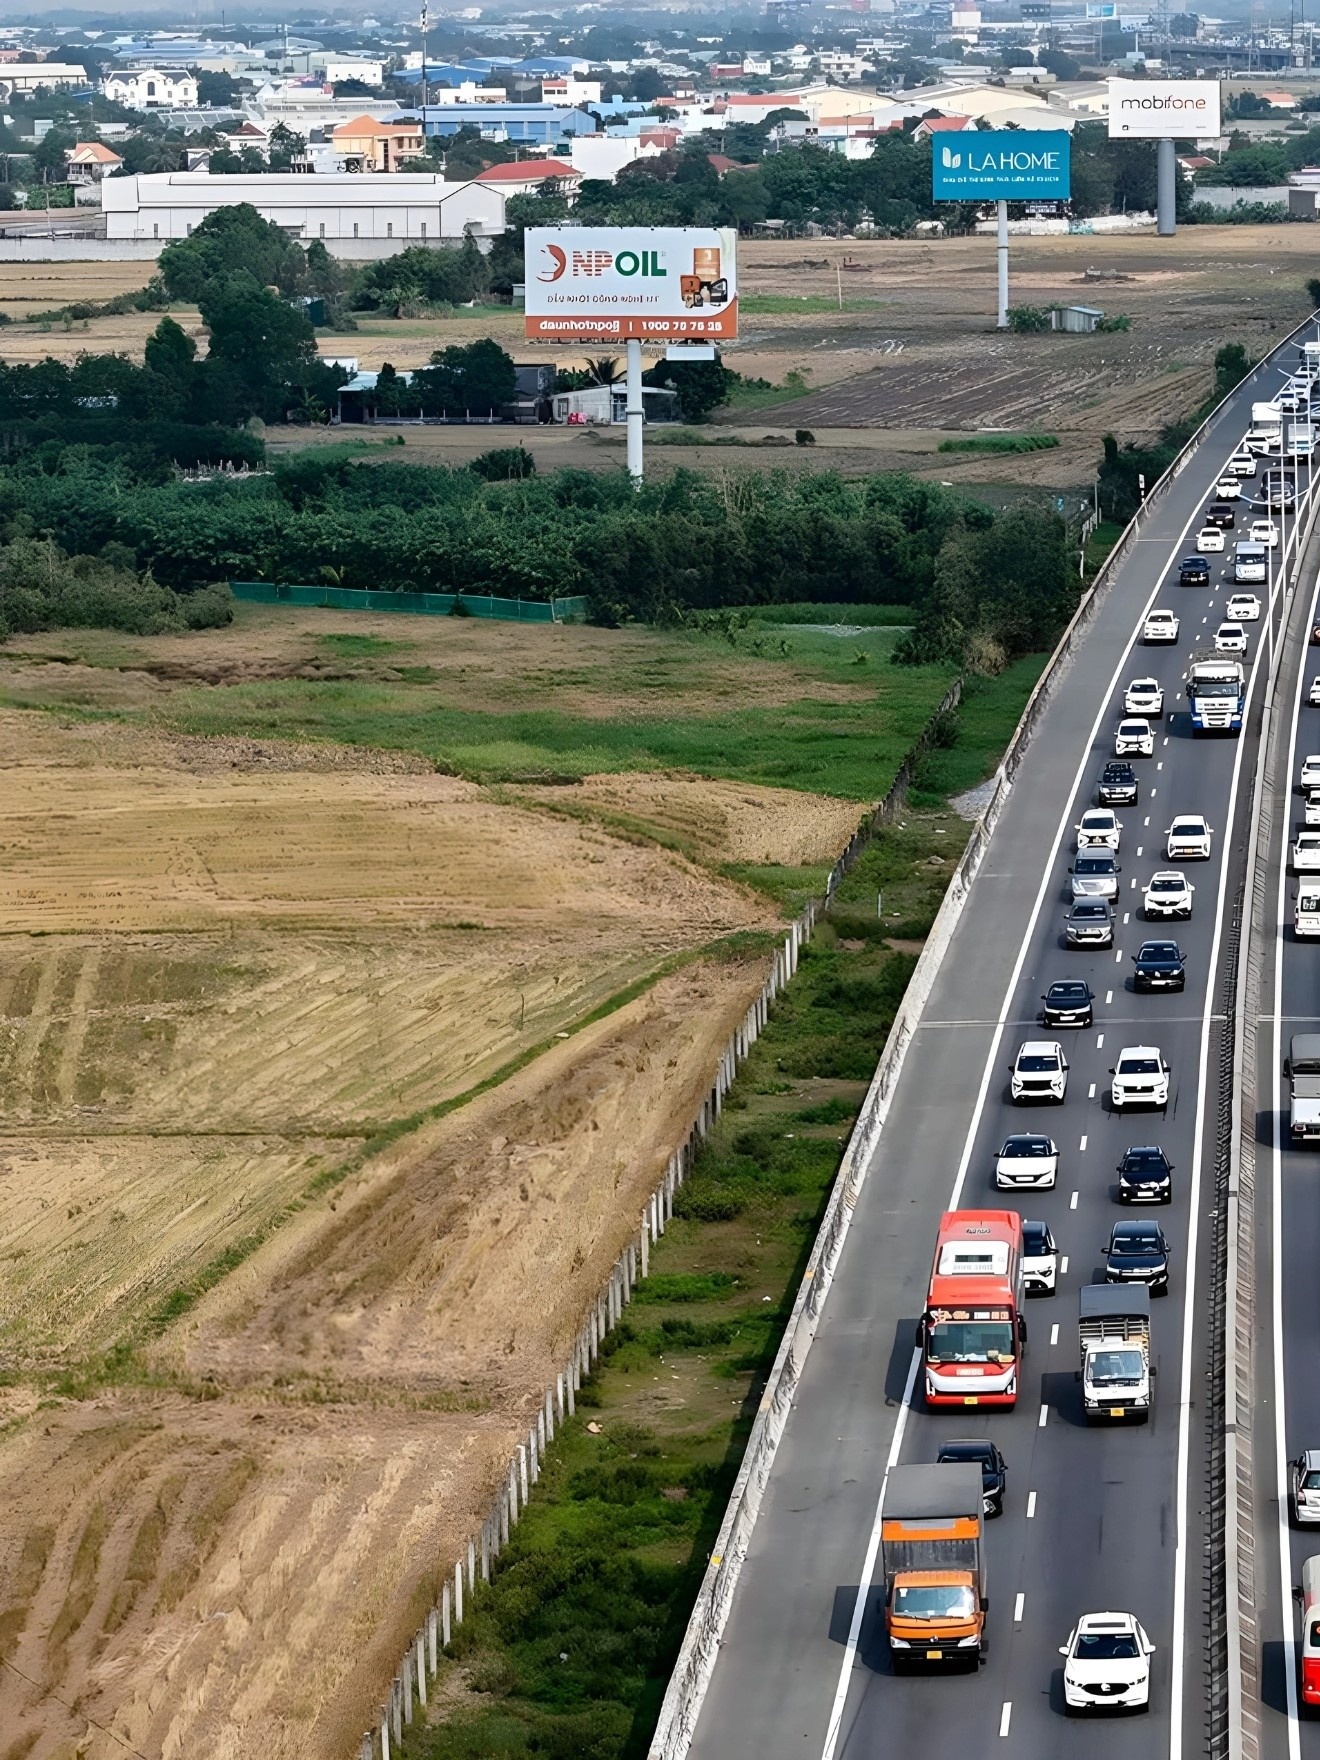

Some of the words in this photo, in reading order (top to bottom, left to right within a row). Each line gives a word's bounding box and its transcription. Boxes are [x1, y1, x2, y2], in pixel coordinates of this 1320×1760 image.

[1121, 94, 1207, 110] mobifone
[968, 152, 998, 171] LA
[1000, 152, 1060, 170] HOME
